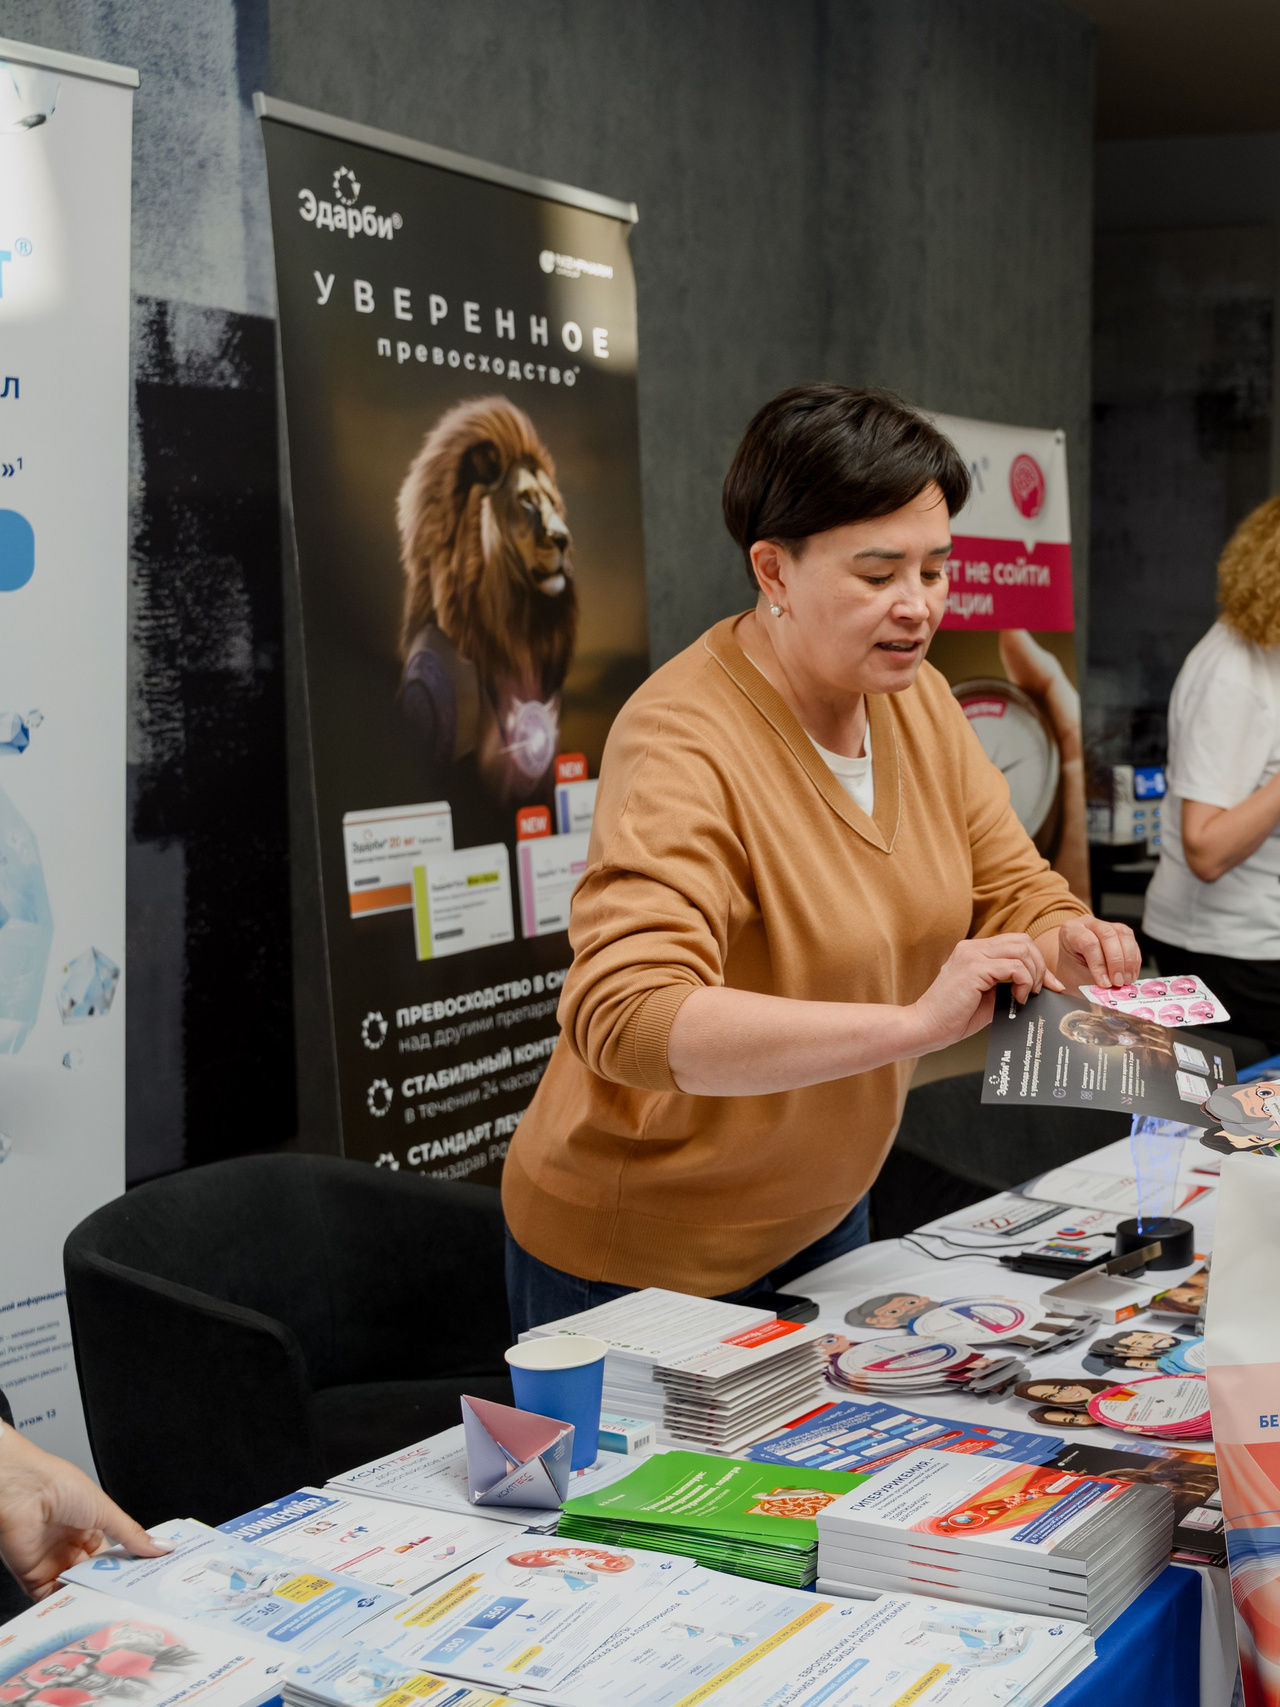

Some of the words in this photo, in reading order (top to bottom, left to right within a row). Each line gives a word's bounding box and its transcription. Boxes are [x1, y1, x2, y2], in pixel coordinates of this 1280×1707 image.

[314, 270, 609, 359] УВЕРЕННОЕ
[993, 557, 1050, 587] сойти
[559, 761, 584, 778] NEW
[520, 815, 547, 832] NEW
[396, 978, 532, 1028] ПРЕВОСХОДСТВО
[533, 975, 544, 993] В
[398, 1033, 431, 1053] над
[433, 1015, 494, 1047] другими
[402, 1045, 512, 1098] СТАБИЛЬНЫЙ
[1019, 1071, 1030, 1097] Свобода
[480, 1079, 498, 1100] 24
[407, 1121, 492, 1165] СТАНДАРТ
[849, 1460, 931, 1511] ГИПЕРУРИКЕМИЯ
[306, 1579, 329, 1591] 300
[257, 1602, 280, 1616] 360
[482, 1605, 506, 1620] 360
[630, 1602, 682, 1638] АЛЛОПУРИНОЛА
[440, 1637, 465, 1653] 300
[798, 1637, 850, 1678] ЕВРОПЕЙСКИЙ
[848, 1600, 899, 1640] АЛЛОПУРИНОЛ
[832, 1646, 856, 1663] ВИДЫ
